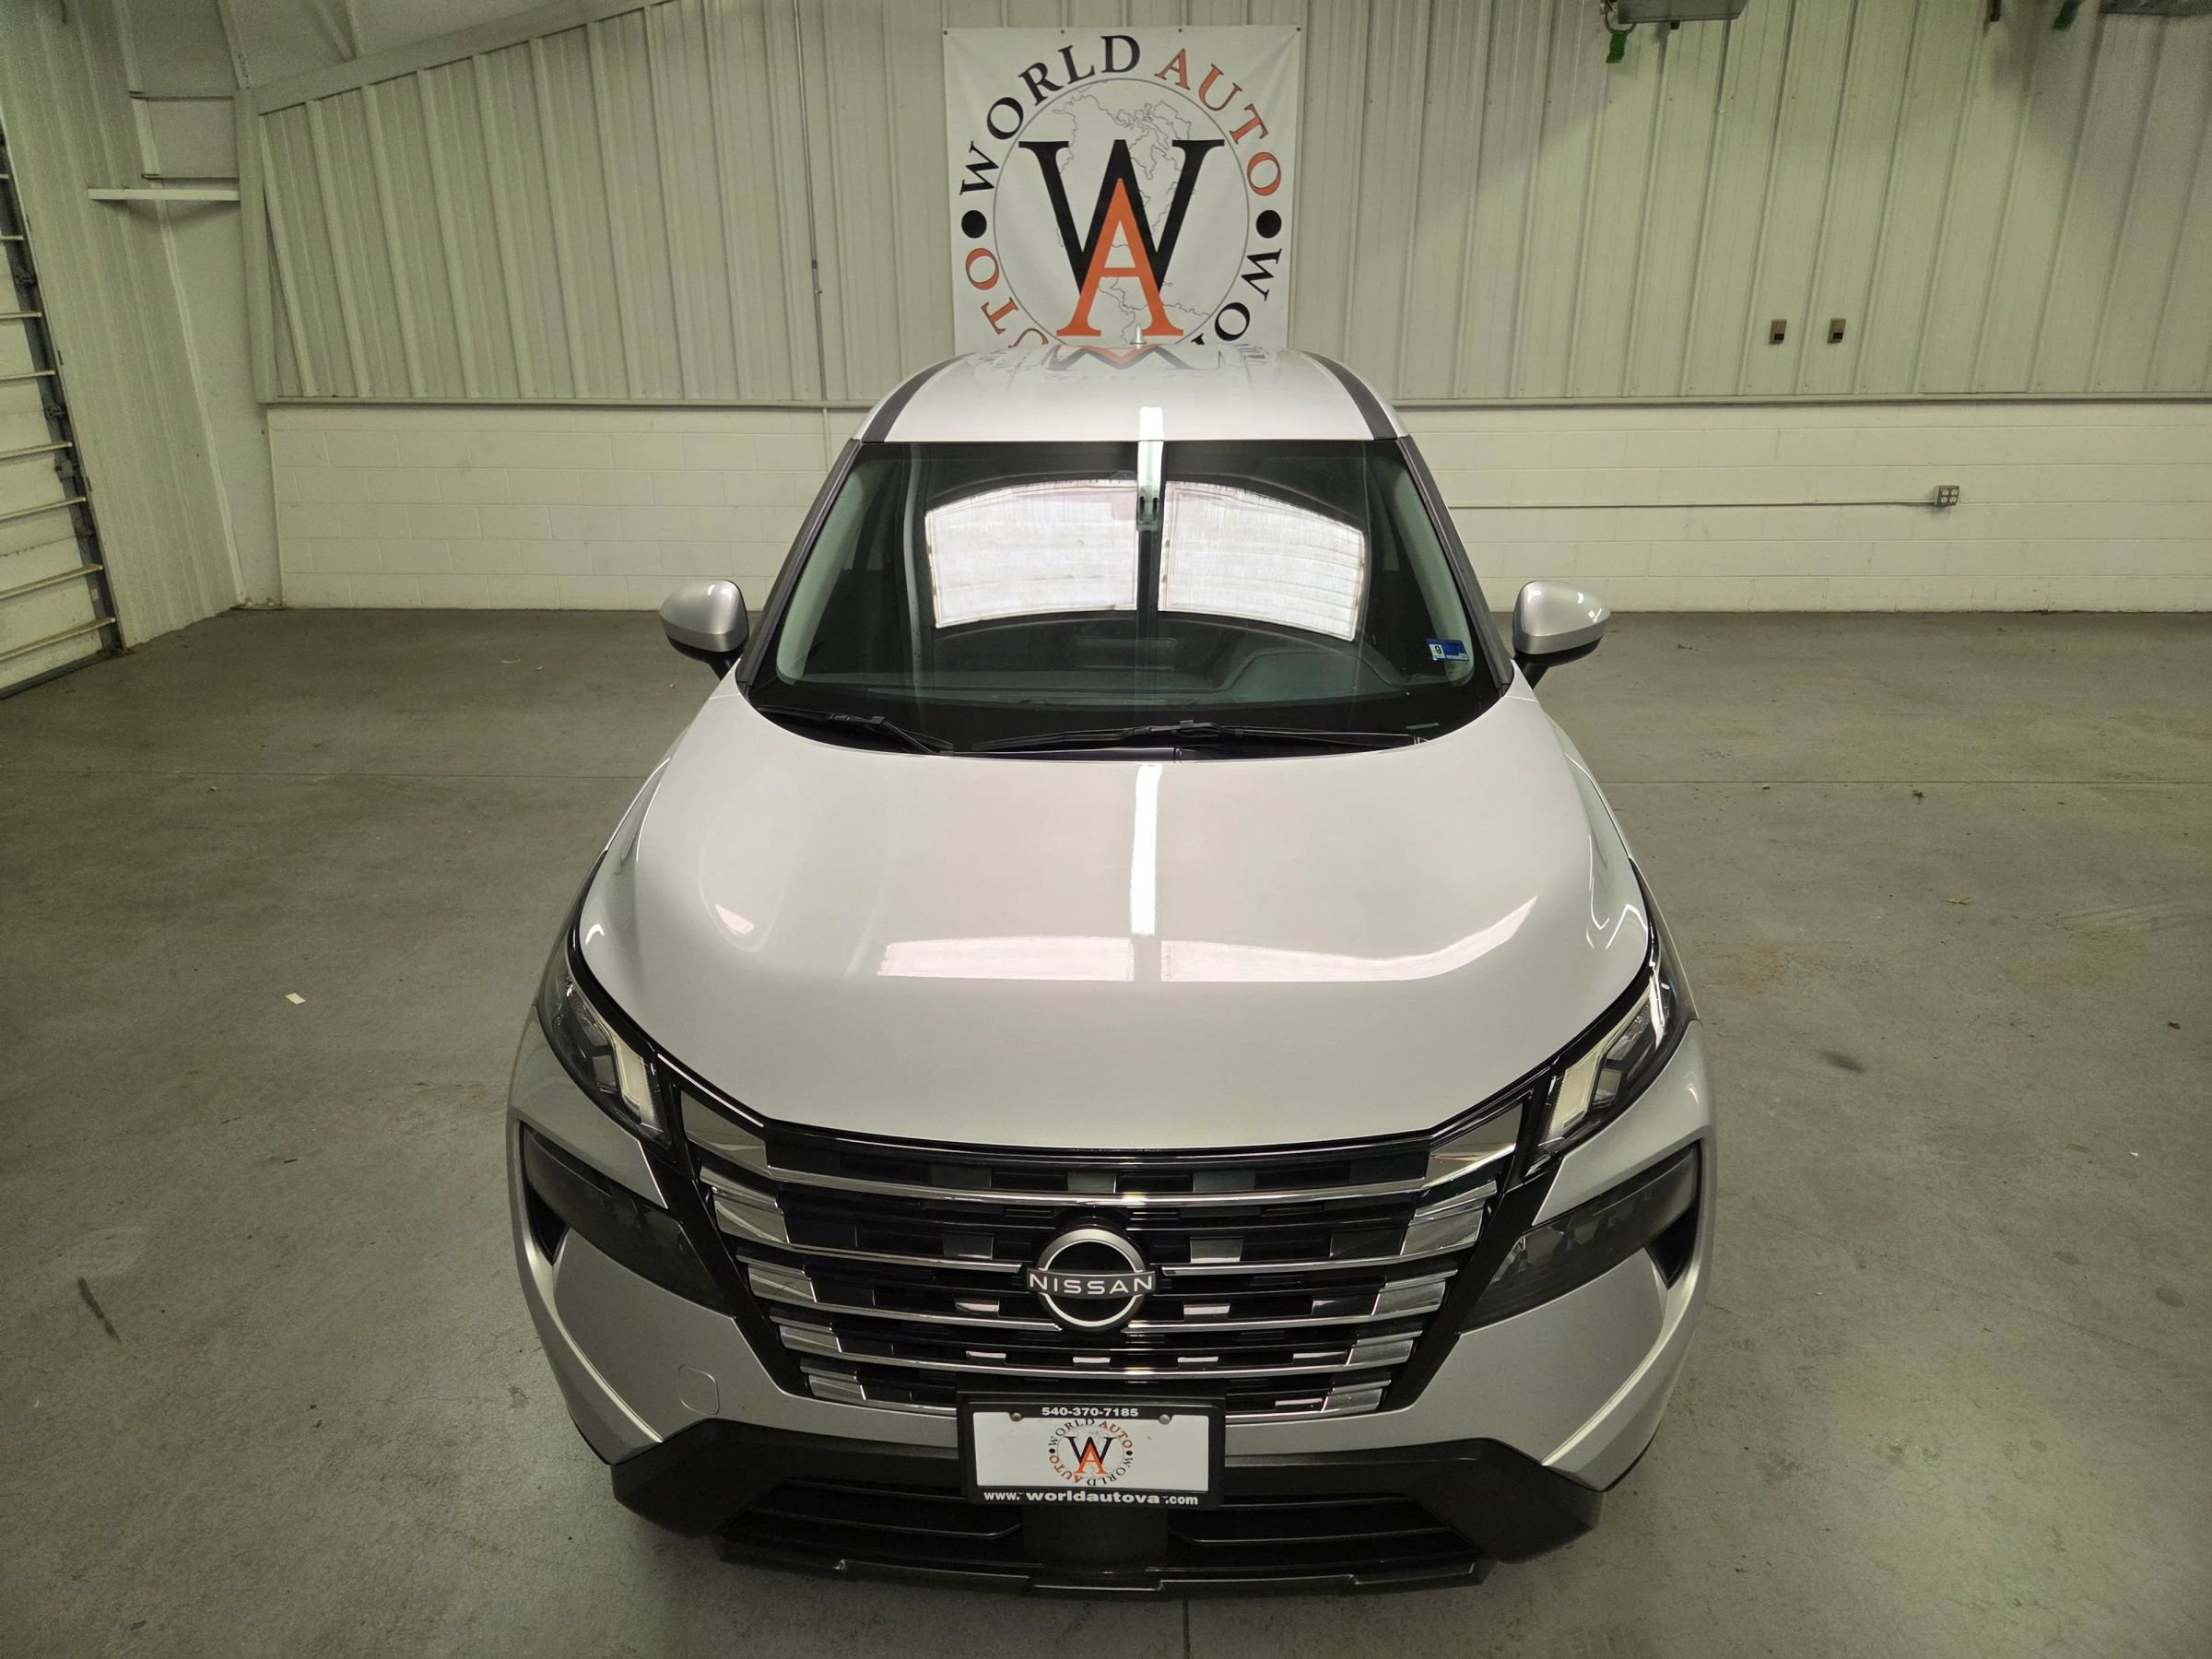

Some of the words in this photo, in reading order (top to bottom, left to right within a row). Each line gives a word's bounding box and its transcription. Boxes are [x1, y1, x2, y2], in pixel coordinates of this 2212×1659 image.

[959, 34, 1142, 196] WORLD
[1154, 47, 1283, 196] AUTO
[1030, 1273, 1153, 1295] NISSAN
[1041, 1406, 1138, 1418] 540-370-7185
[1048, 1418, 1095, 1446] WORLD
[1099, 1420, 1133, 1448] AUTO
[1049, 1455, 1083, 1484] AUTO
[1087, 1457, 1134, 1487] WORLD
